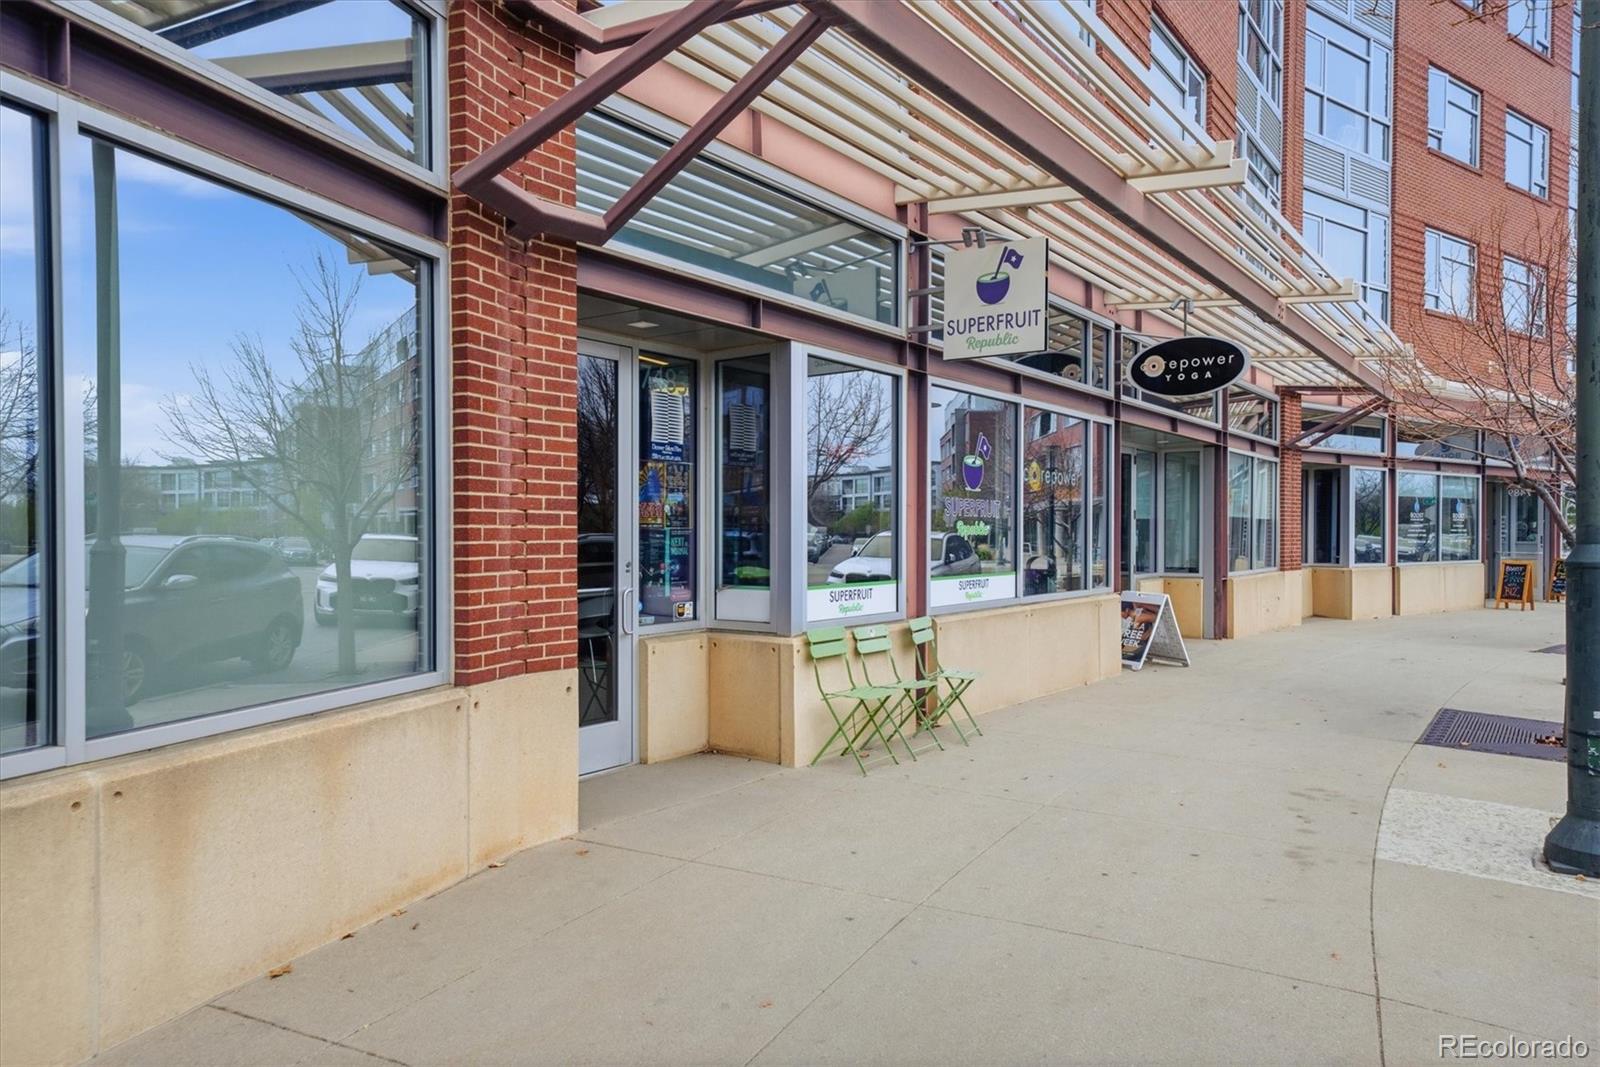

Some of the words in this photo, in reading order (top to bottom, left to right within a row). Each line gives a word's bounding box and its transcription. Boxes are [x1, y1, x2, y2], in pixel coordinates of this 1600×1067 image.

[947, 309, 1041, 336] SUPERFRUIT
[966, 331, 1018, 352] Republic
[1165, 371, 1212, 382] YOGA
[944, 497, 1001, 518] SUPERFRUIT
[959, 578, 989, 591] SUPERFRUIT
[829, 588, 873, 602] SUPERFRUIT
[1122, 629, 1144, 640] REE
